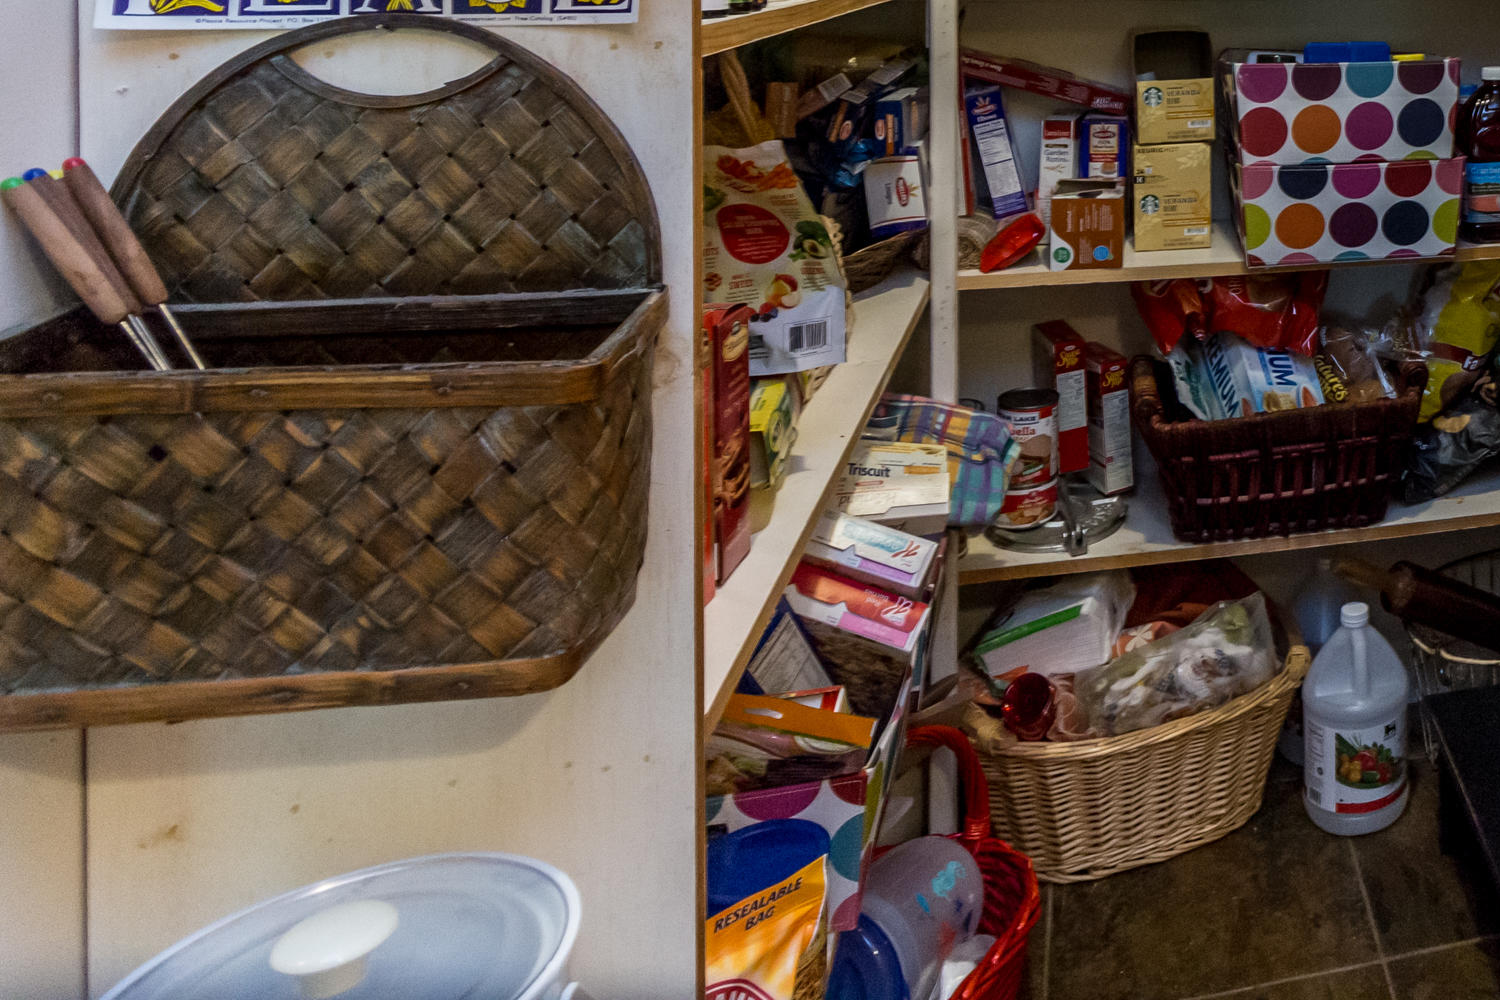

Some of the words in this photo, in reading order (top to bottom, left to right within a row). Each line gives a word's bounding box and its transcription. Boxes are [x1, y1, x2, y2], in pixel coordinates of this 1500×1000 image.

[847, 462, 891, 478] Triscuit
[713, 876, 803, 934] RESEALABLE
[744, 905, 776, 931] BAG
